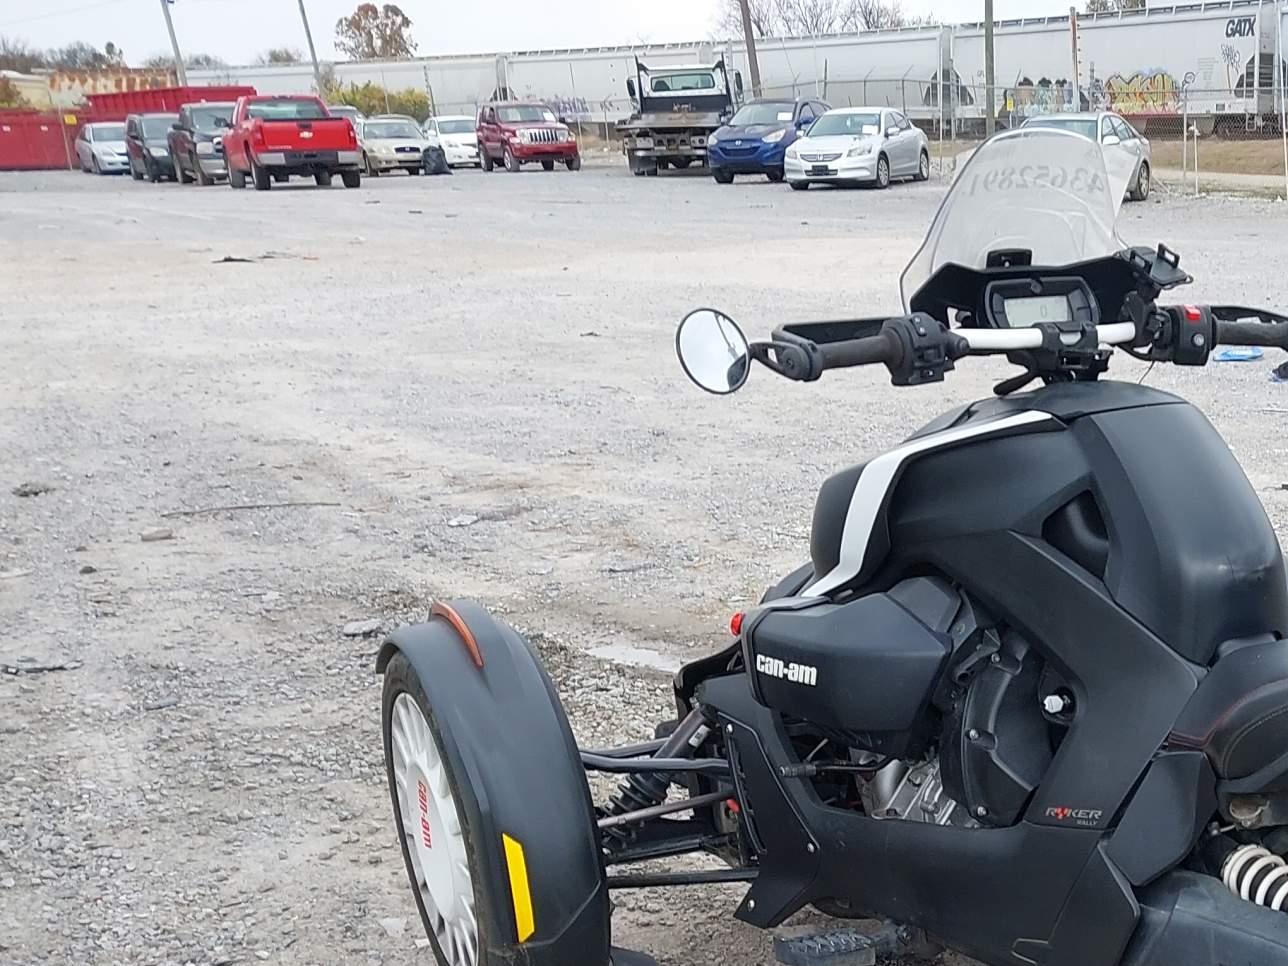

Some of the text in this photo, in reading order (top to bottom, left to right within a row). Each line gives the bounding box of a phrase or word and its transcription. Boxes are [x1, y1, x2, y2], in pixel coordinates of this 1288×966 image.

[1225, 18, 1257, 38] GATX
[756, 653, 818, 686] can-am
[417, 780, 432, 849] can-am
[1045, 807, 1103, 820] RYKER
